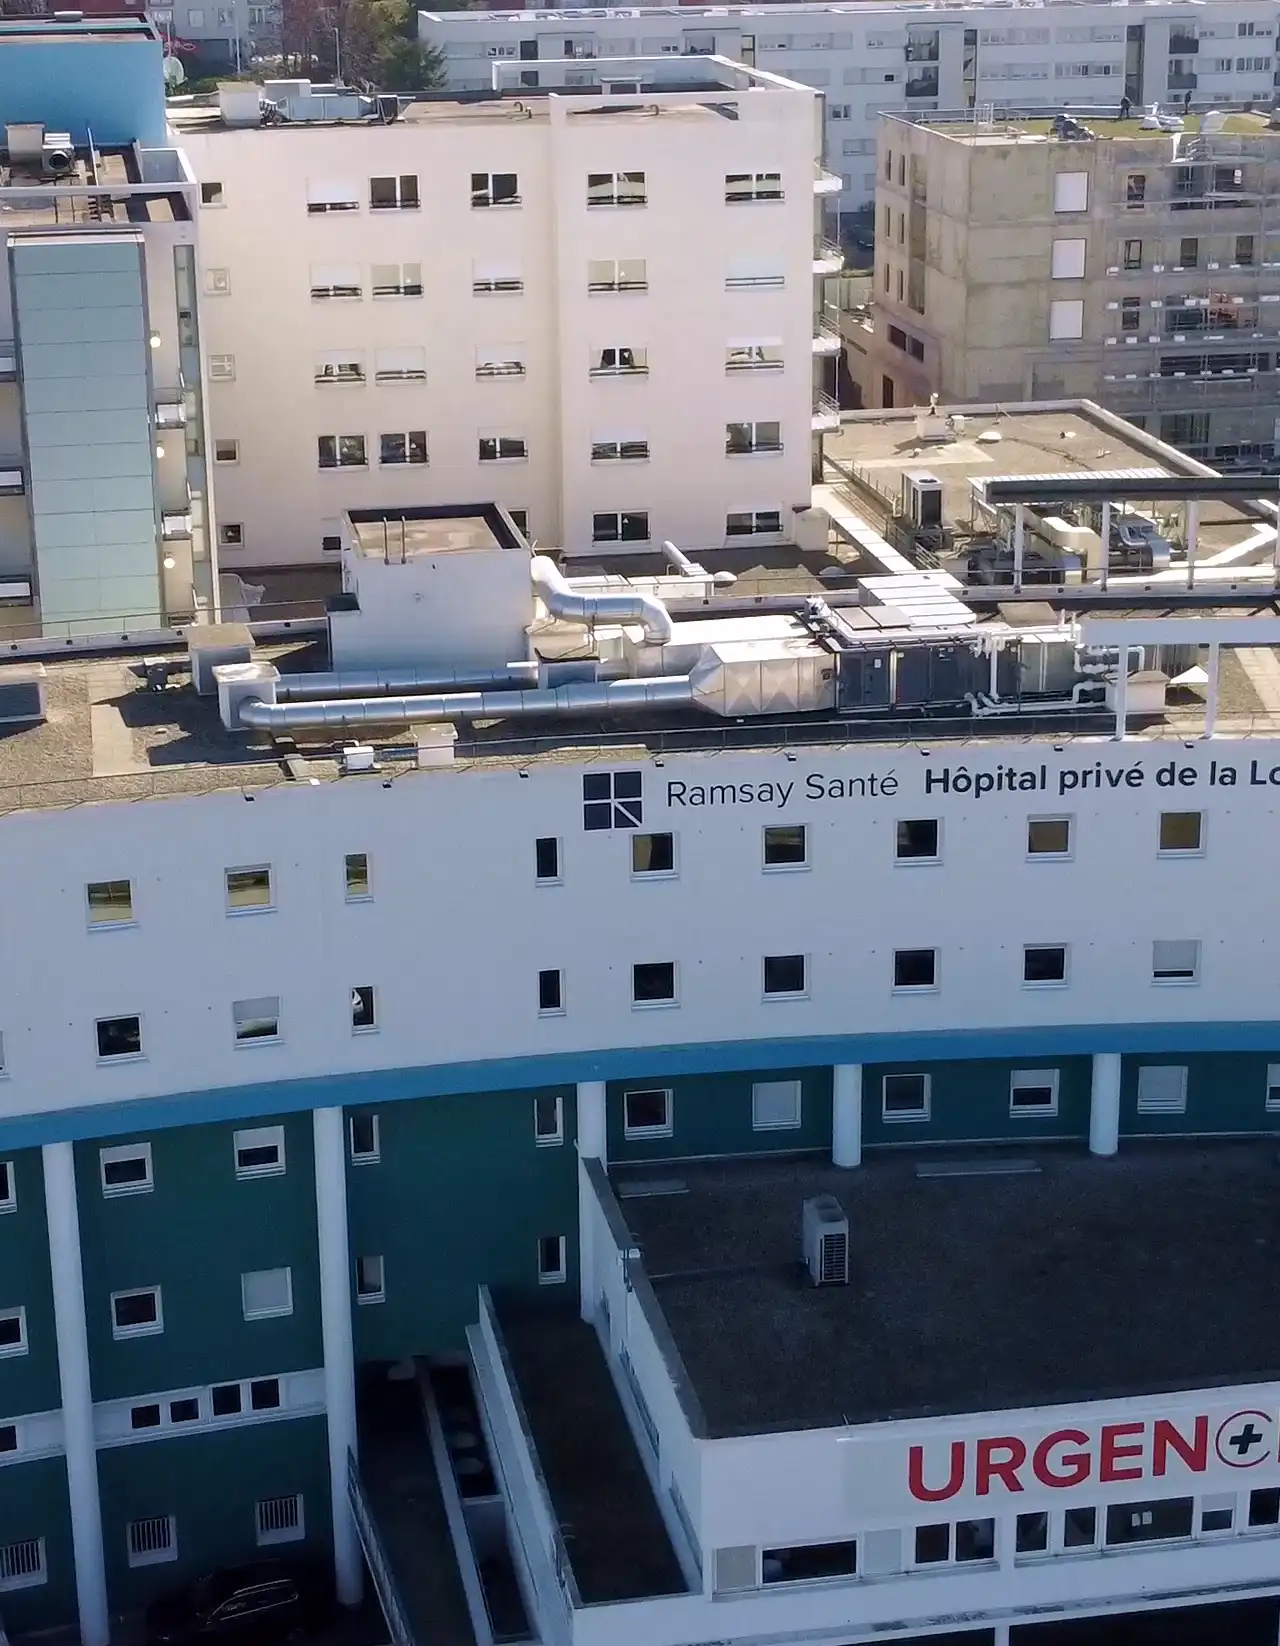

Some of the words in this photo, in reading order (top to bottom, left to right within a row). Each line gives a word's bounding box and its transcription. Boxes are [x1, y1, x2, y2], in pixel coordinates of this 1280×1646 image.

[667, 781, 795, 809] Ramsay
[805, 769, 899, 799] Santé
[924, 765, 1047, 798] Hôpital
[1058, 761, 1145, 795] privé
[1155, 761, 1198, 787] de
[1209, 760, 1238, 786] la
